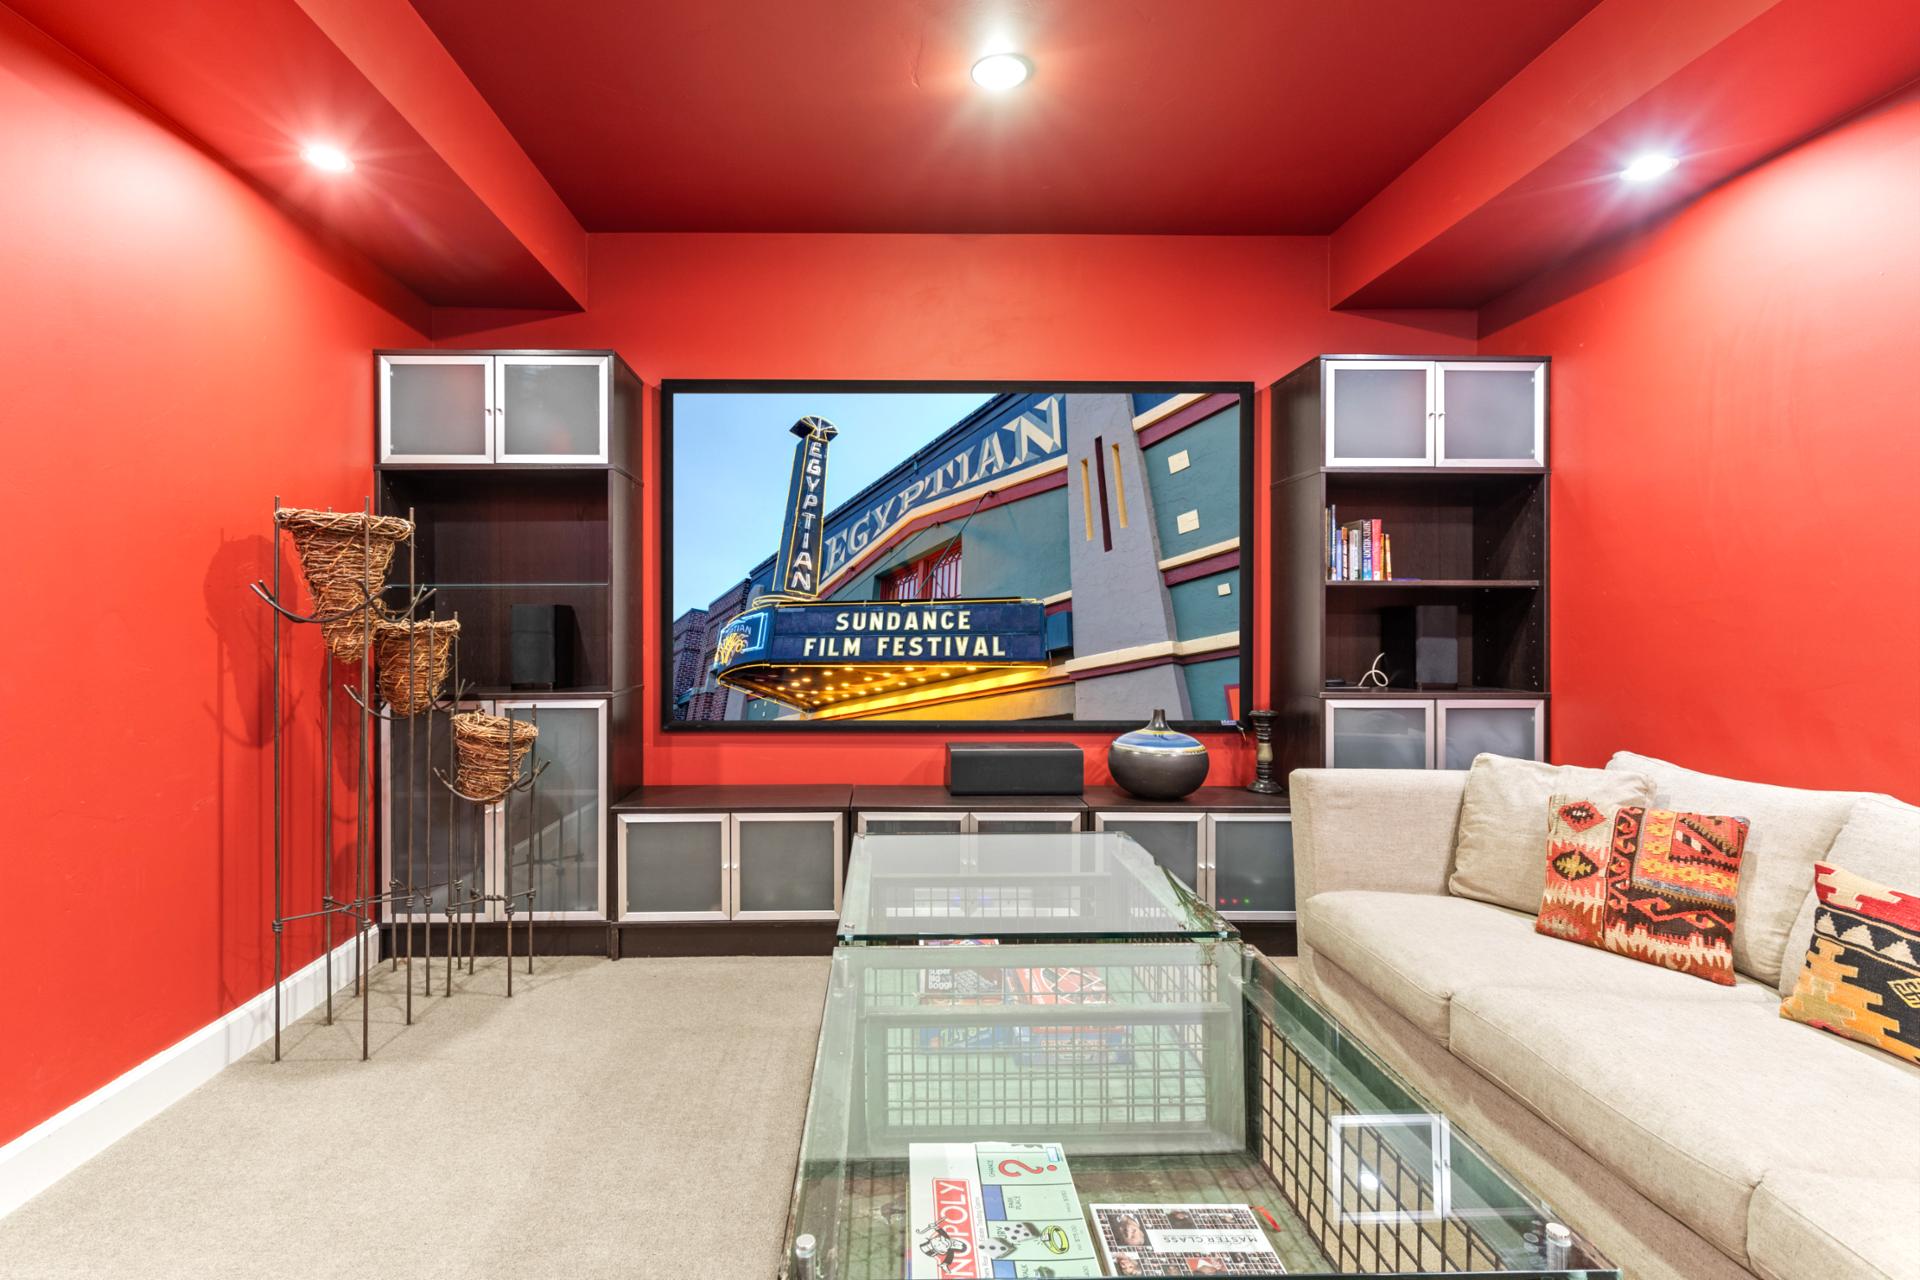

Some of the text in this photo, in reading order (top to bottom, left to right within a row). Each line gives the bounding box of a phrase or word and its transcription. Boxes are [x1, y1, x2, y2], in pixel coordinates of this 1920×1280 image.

[790, 441, 823, 591] EGYPTIAN
[823, 395, 1062, 578] EGYPTIAN
[803, 636, 1006, 657] FILM FESTIVAL
[835, 610, 972, 631] SUNDANCE
[940, 1181, 974, 1276] NOPOLY
